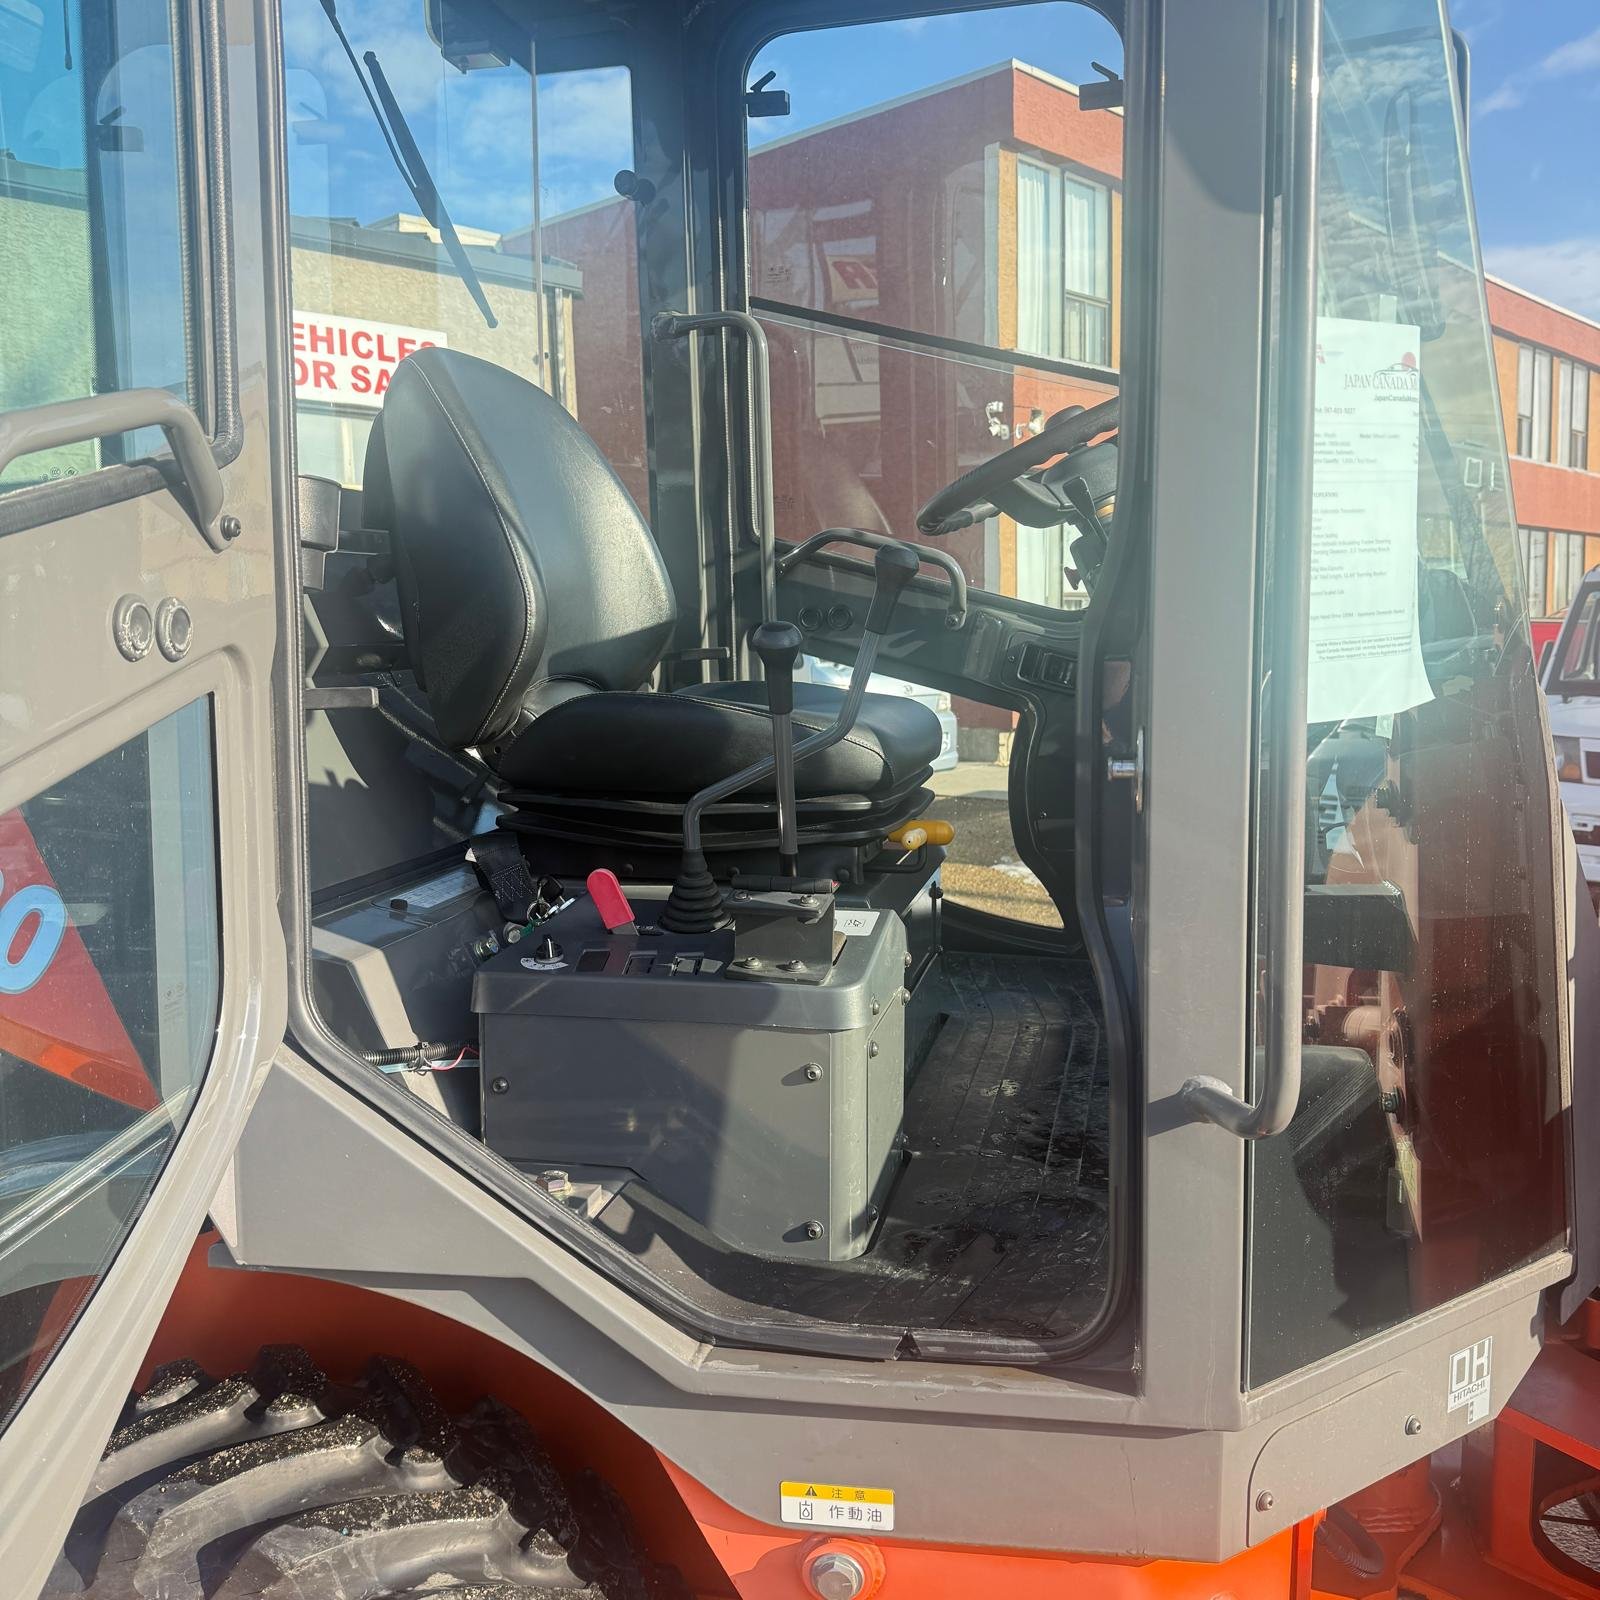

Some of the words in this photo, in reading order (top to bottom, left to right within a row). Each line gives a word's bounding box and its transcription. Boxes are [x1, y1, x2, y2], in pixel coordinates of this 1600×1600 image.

[292, 322, 437, 363] EHICLE
[294, 357, 338, 390] OR
[351, 365, 392, 395] SA
[1344, 373, 1372, 390] JAPAN
[1373, 374, 1409, 391] CANADA
[0, 870, 67, 994] 0
[1453, 1379, 1486, 1403] HITACHI
[831, 1487, 866, 1501] 注意
[829, 1504, 882, 1522] 作動油
